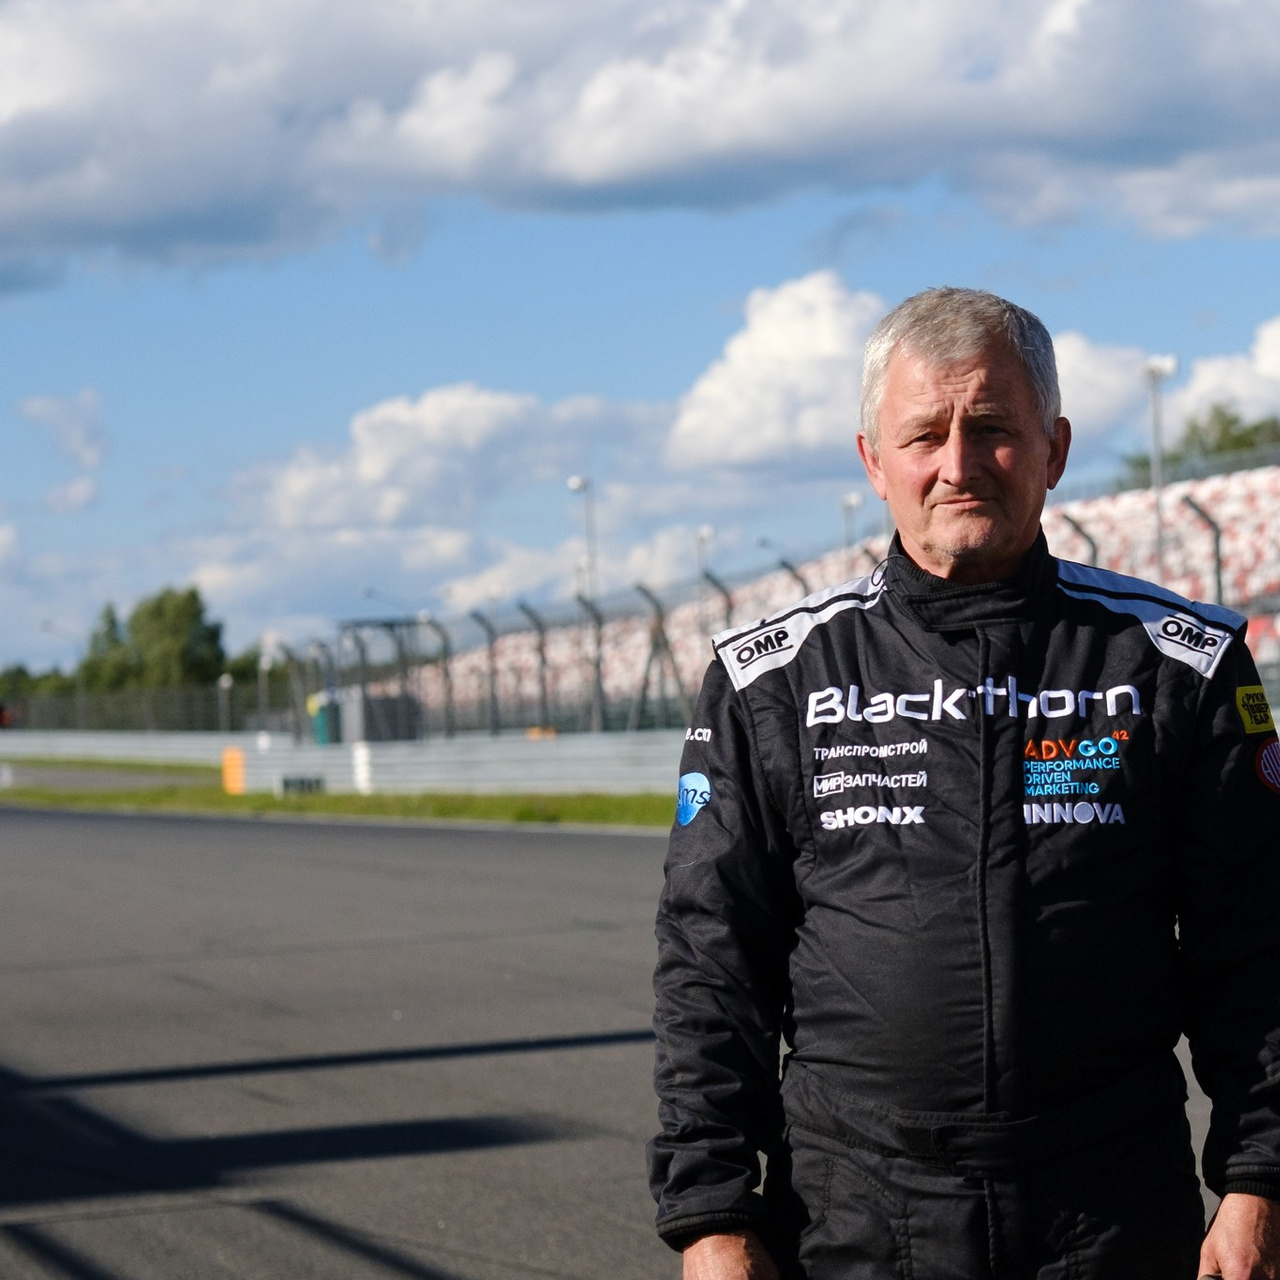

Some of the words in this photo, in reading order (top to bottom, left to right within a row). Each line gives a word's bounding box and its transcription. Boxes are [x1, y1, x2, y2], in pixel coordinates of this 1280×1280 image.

[1162, 620, 1218, 650] OMP
[736, 630, 789, 664] OMP
[806, 675, 1141, 728] Blackthorn
[813, 739, 928, 760] ТРАНСПРОМСТРОЙ
[1023, 757, 1120, 773] PERFORMANCE
[1024, 771, 1071, 784] DRIVEN
[1025, 782, 1100, 796] MARKETING
[820, 805, 925, 831] SHONX
[1023, 802, 1126, 824] INNOVA
